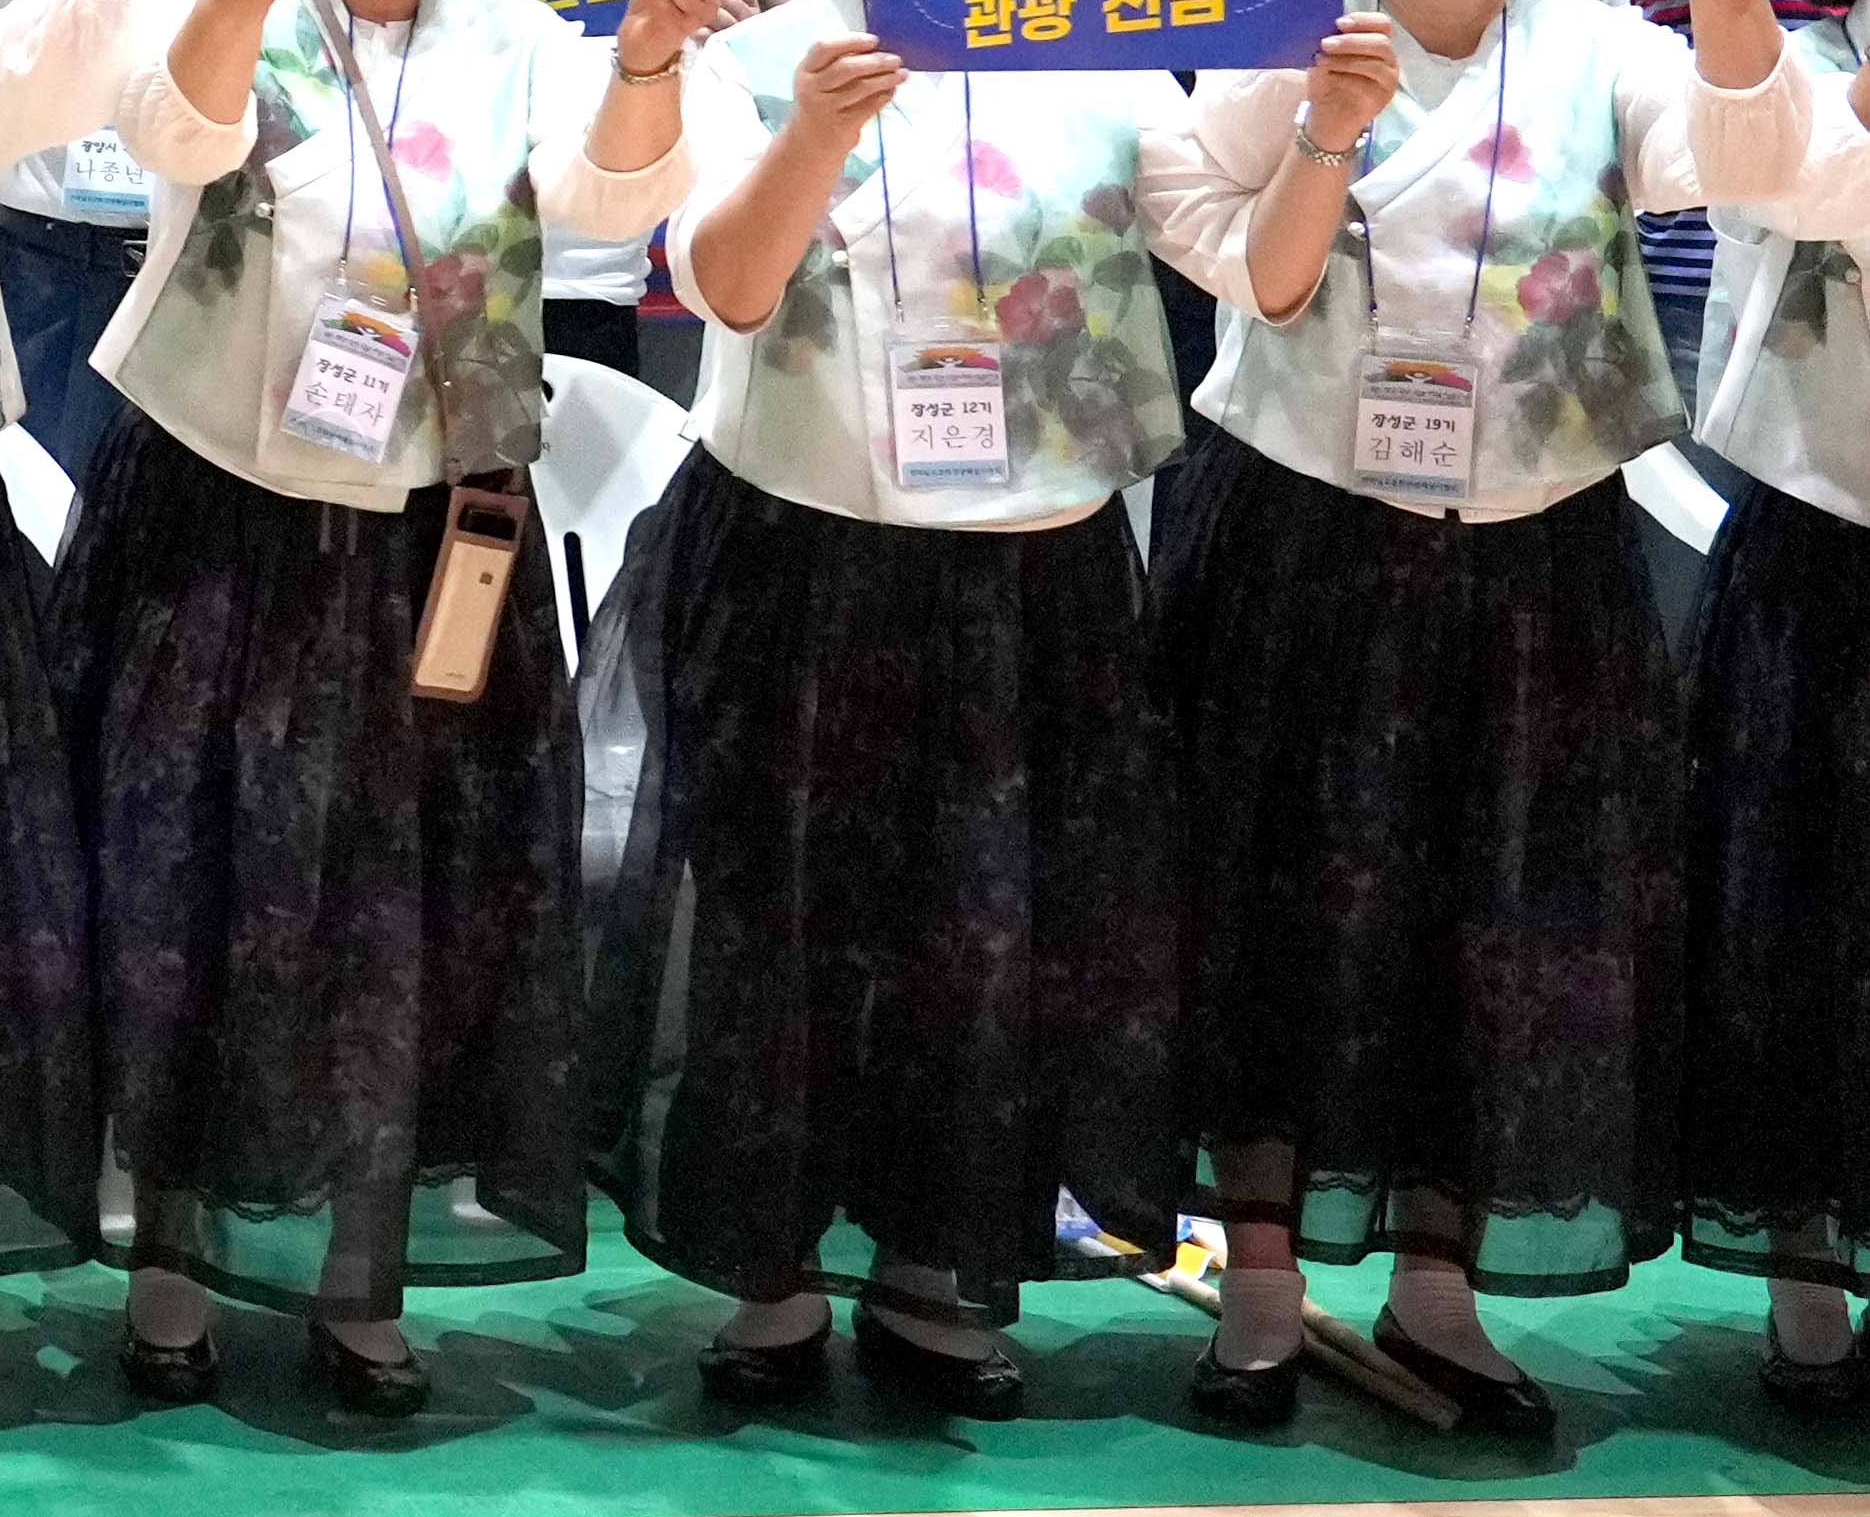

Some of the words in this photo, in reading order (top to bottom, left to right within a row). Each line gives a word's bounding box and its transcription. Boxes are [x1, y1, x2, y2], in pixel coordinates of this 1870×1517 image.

[911, 402, 955, 417] 장성군
[961, 401, 992, 414] 12기
[1371, 413, 1416, 430] 장성군
[1425, 417, 1455, 432] 19기
